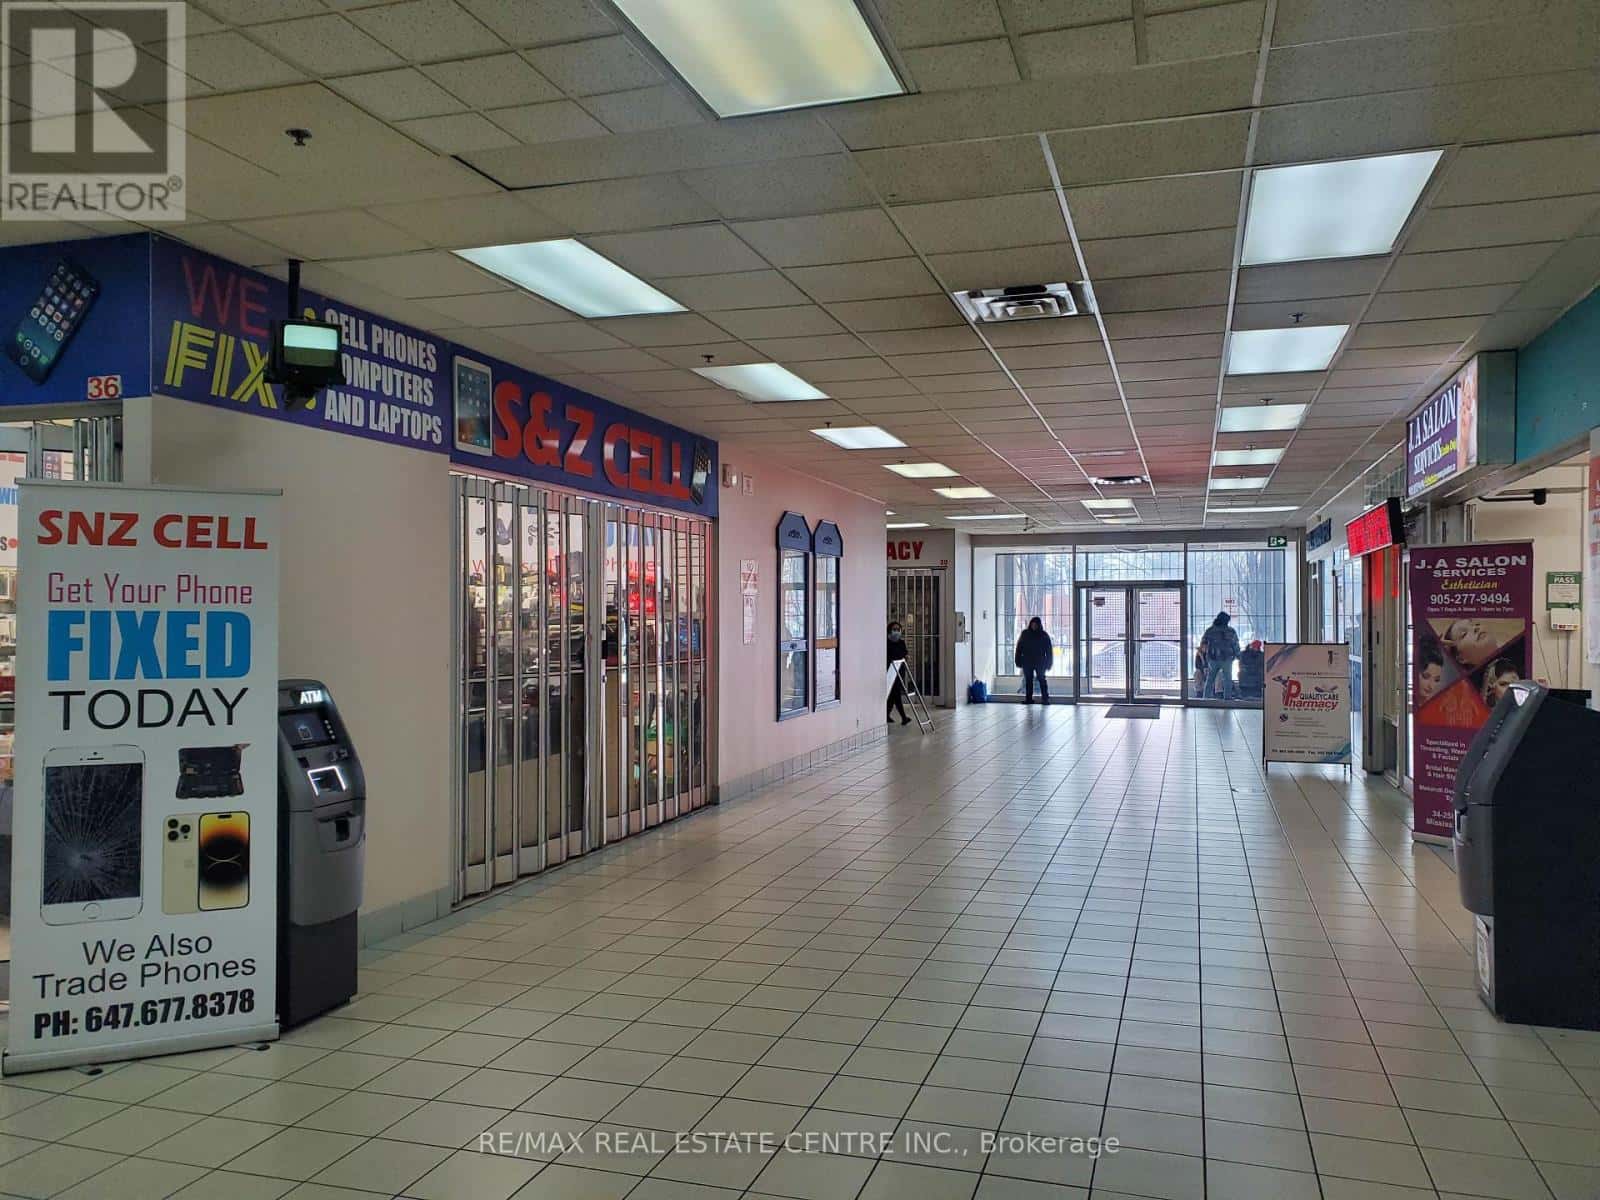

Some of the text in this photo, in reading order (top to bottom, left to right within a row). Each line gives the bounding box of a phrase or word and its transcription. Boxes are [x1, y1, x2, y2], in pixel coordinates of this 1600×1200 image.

[181, 256, 270, 337] WE
[164, 320, 278, 409] FIX
[372, 324, 437, 373] PHONES
[88, 376, 119, 399] 36
[341, 352, 434, 407] OMPUTERS
[324, 388, 443, 444] AND LAPTOPS
[1422, 384, 1457, 442] SALON
[493, 380, 690, 500] S&Z CELL
[37, 509, 139, 547] SNZ
[153, 514, 268, 550] CELL
[1432, 567, 1507, 578] SERVICES
[1455, 555, 1527, 568] SALON
[1554, 576, 1575, 584] PASS
[48, 572, 253, 605] Get Your Phone
[1430, 593, 1511, 605] 905-277-9494
[47, 610, 252, 681] FIXED
[48, 687, 249, 731] TODAY
[1283, 679, 1339, 710] Pharmacy
[82, 933, 213, 966] We Also
[33, 957, 257, 999] Trade Phones
[33, 988, 256, 1039] PH: 647.677.8378
